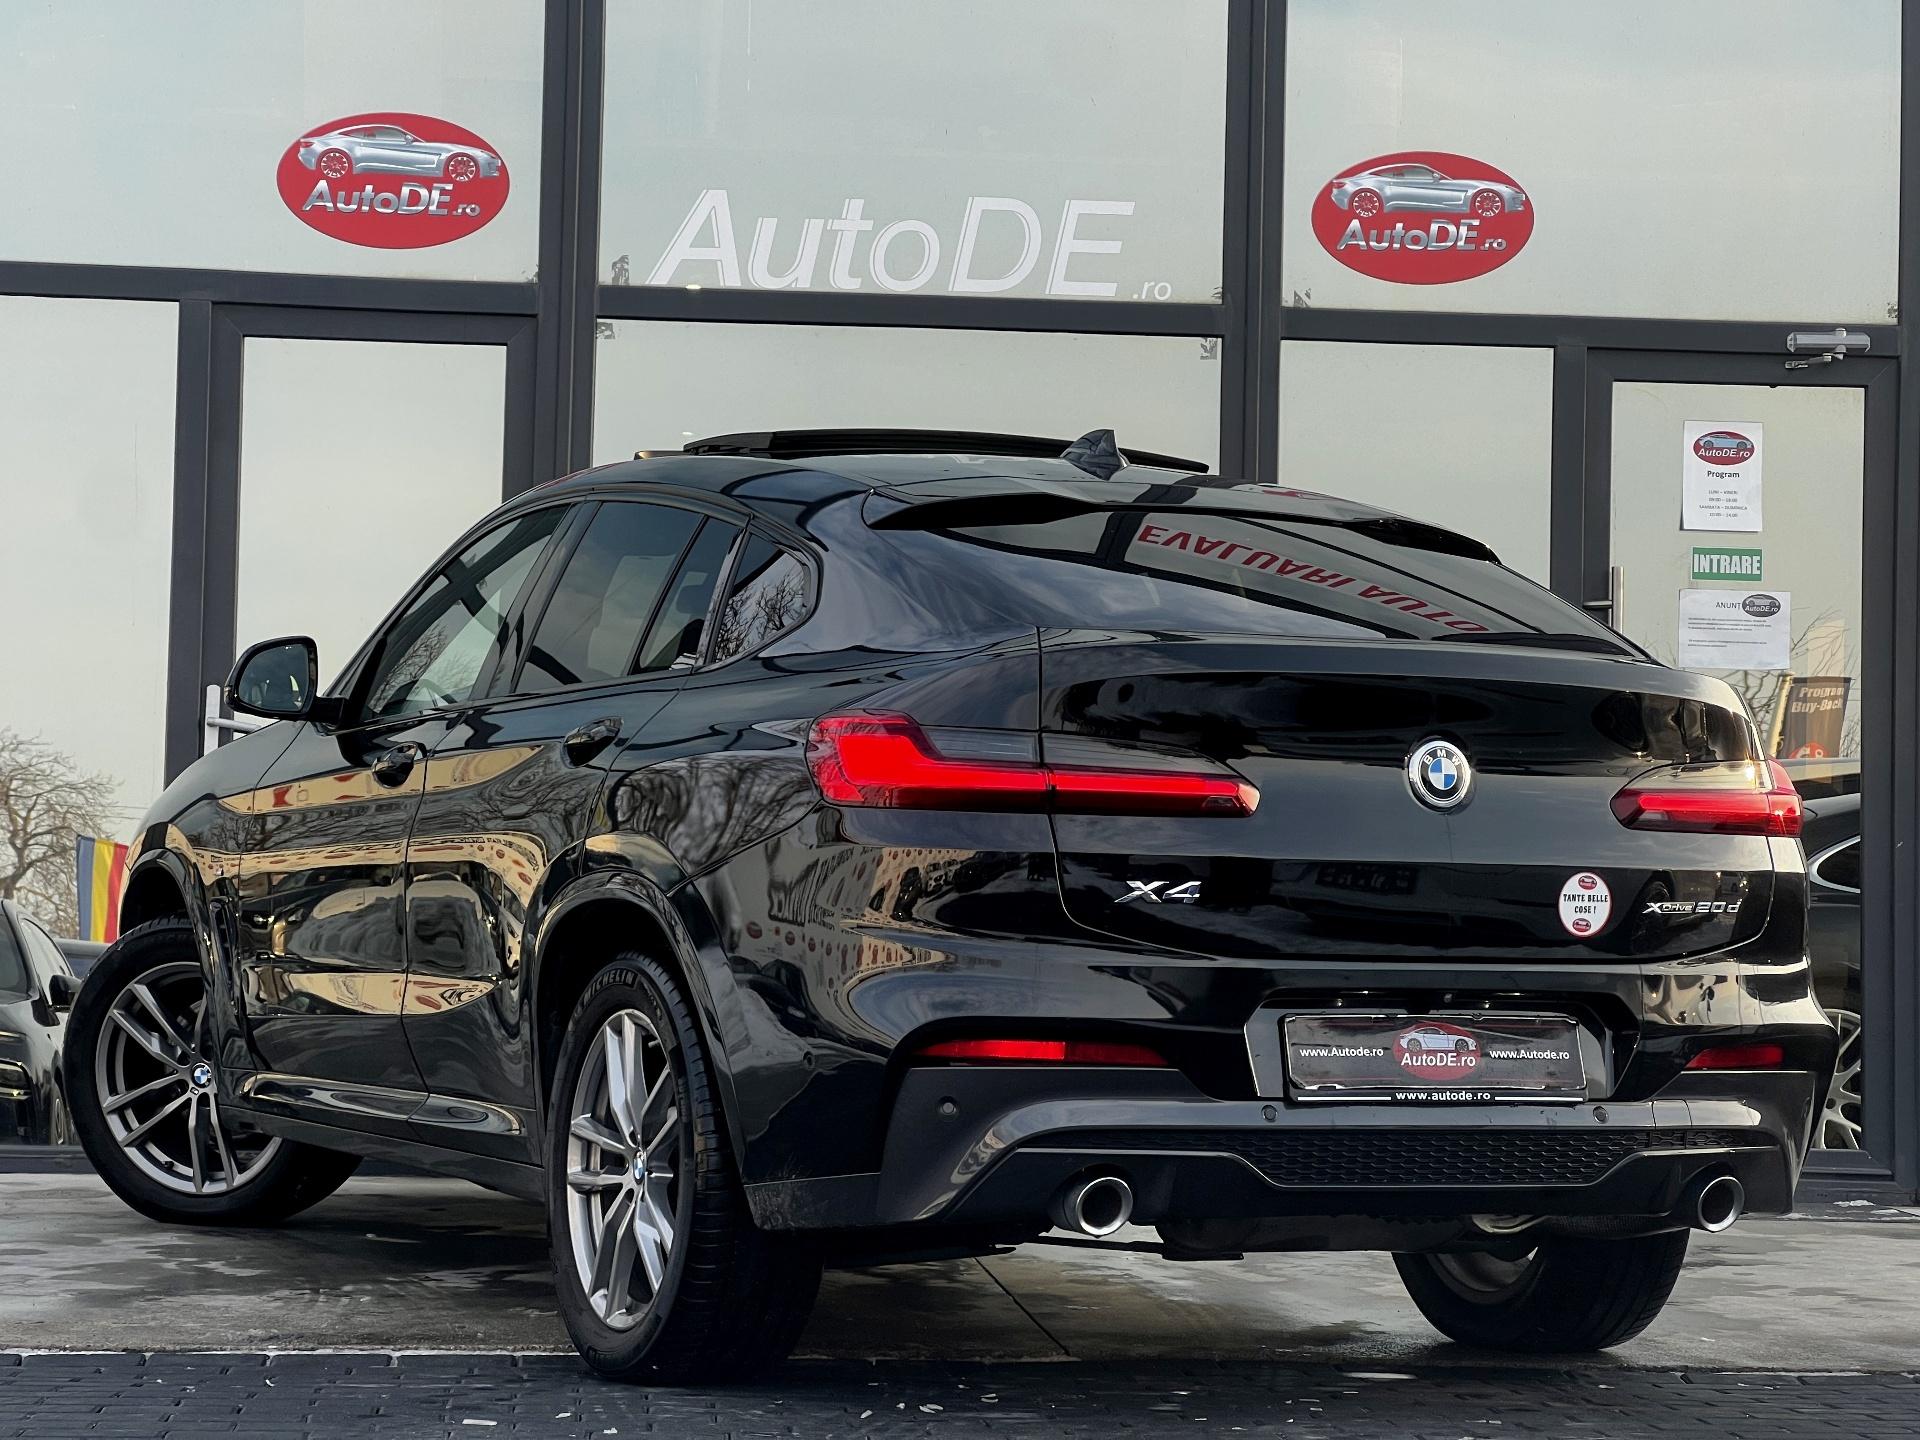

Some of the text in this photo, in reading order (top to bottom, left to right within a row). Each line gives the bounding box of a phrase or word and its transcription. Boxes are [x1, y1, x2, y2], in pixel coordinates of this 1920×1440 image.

[1697, 448, 1750, 459] AutoDE.ro
[1707, 470, 1740, 480] Program
[1693, 553, 1761, 575] INTRARE
[1423, 748, 1462, 767] BMW
[1113, 880, 1203, 904] X4
[1563, 893, 1609, 903] TANTE BELLE
[1574, 905, 1592, 914] COSE
[1299, 1046, 1384, 1057] www.Autode.ro
[1489, 1049, 1570, 1060] www.Autode.ro
[1400, 1052, 1476, 1067] AutoDE.ro
[1395, 1091, 1491, 1101] www.autode.ro
